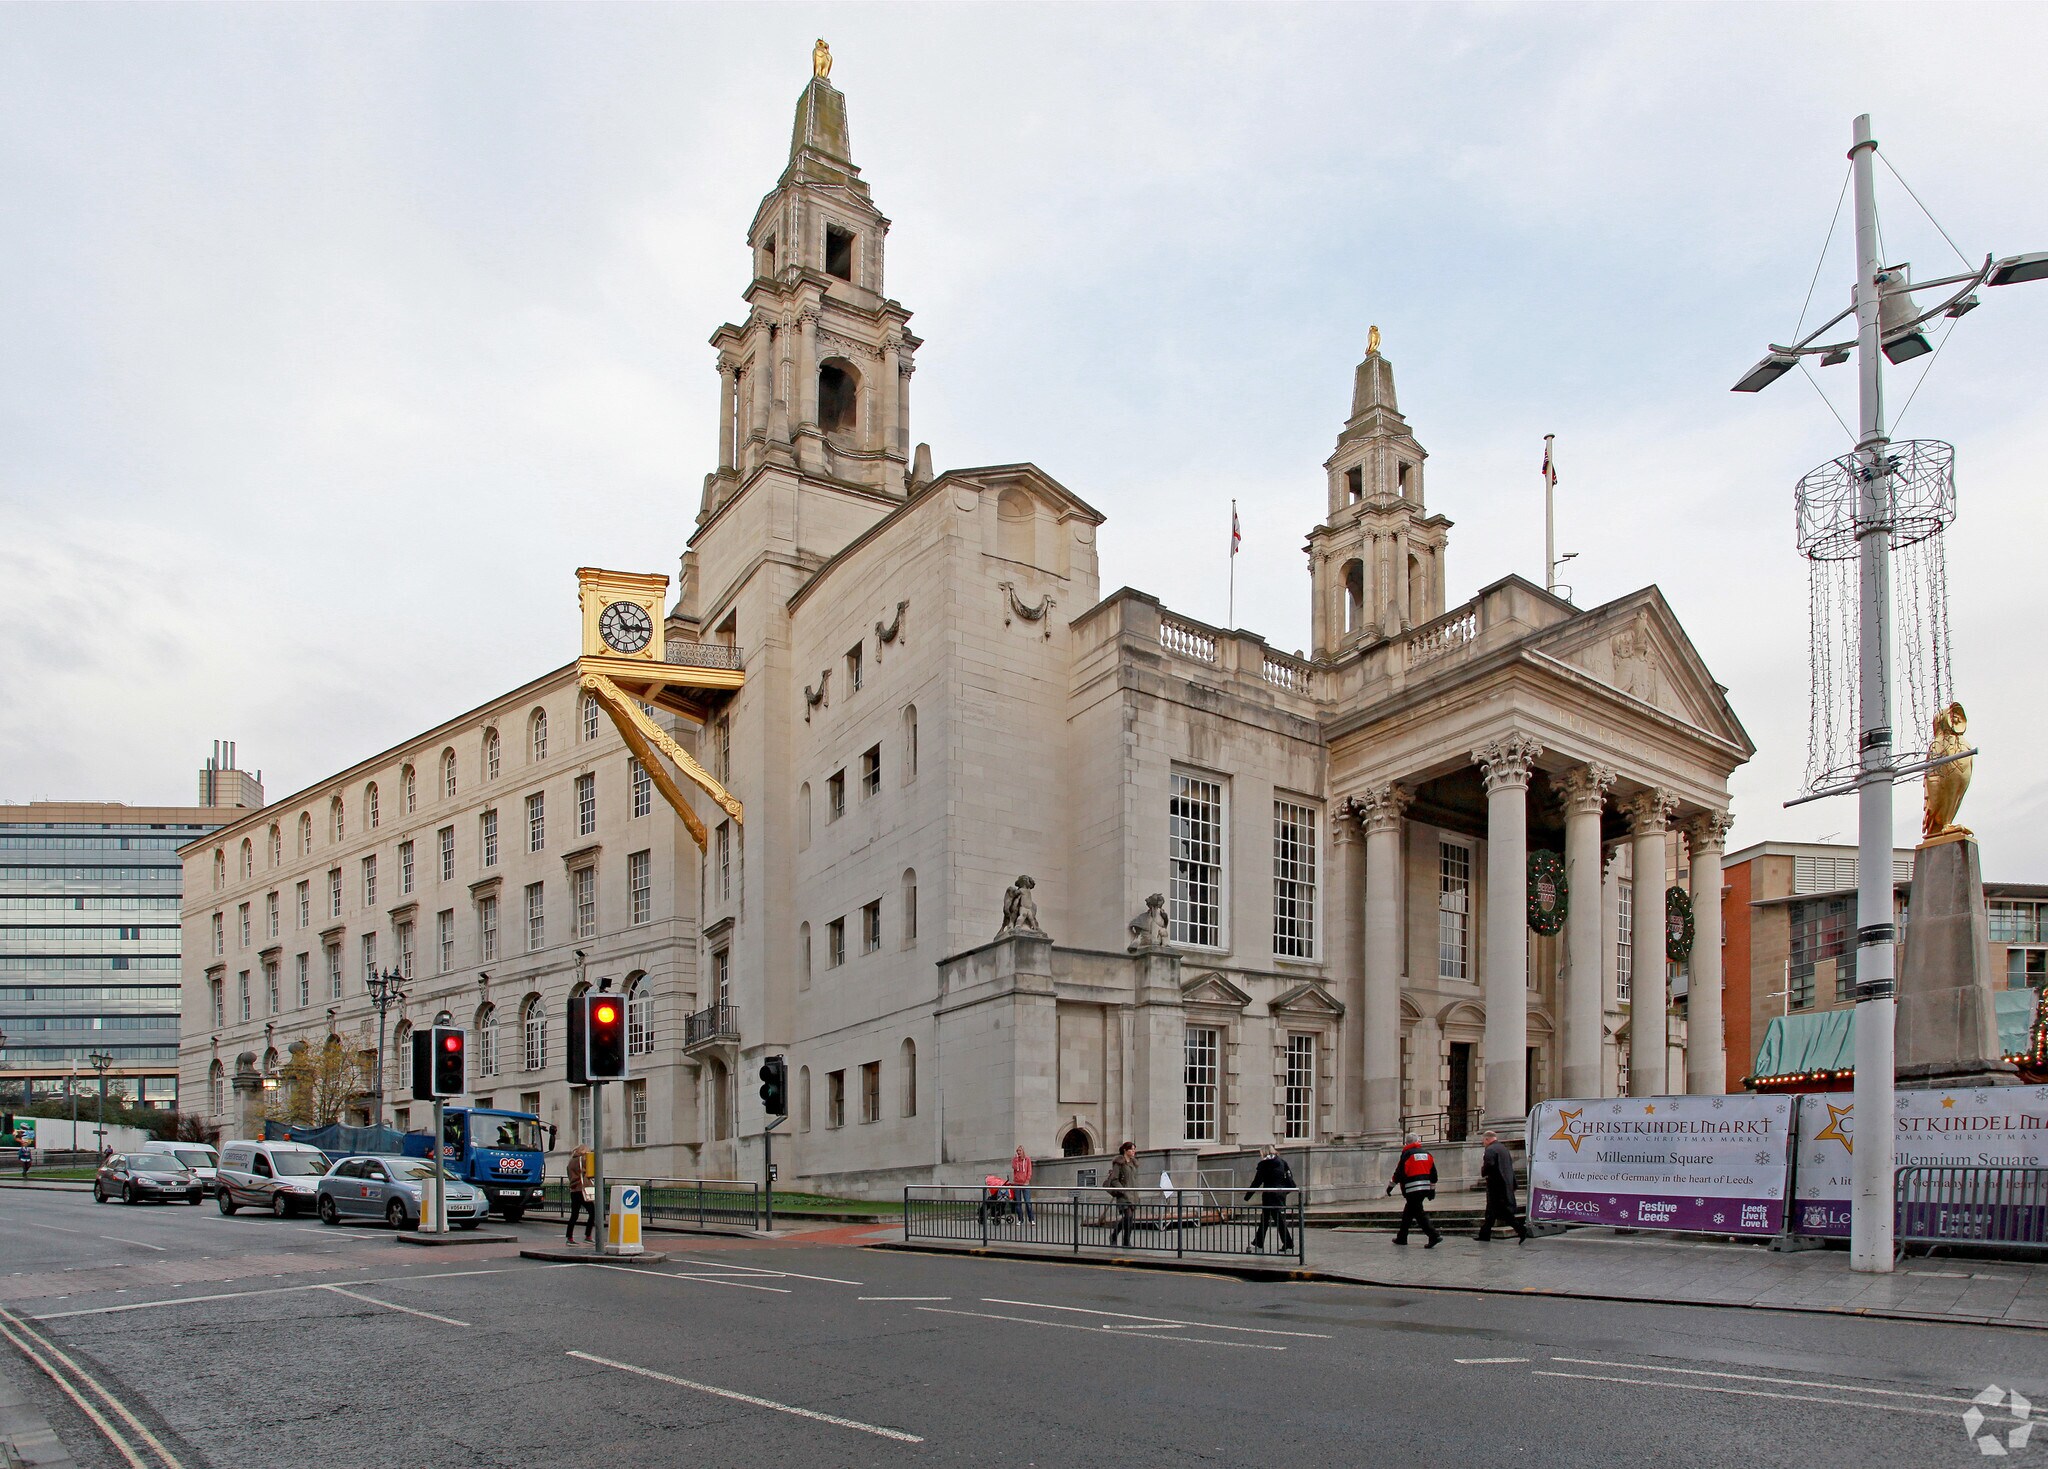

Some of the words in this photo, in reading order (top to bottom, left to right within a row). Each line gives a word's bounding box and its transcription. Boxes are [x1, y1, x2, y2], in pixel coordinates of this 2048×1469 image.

[1568, 1117, 1773, 1135] CHRISTKINDELMARKT
[1943, 1133, 2037, 1141] CHRISTMAS
[1596, 1151, 1665, 1163] Millennium
[1669, 1152, 1714, 1166] Square
[1895, 1152, 1971, 1166] illennium
[1978, 1152, 2039, 1166] Square
[1567, 1171, 1585, 1179] little
[1587, 1173, 1608, 1181] piece
[1610, 1172, 1621, 1180] of
[1621, 1173, 1660, 1183] Germany
[1662, 1174, 1671, 1182] in
[1673, 1174, 1687, 1183] the
[1689, 1174, 1711, 1183] heart
[1713, 1175, 1725, 1184] of
[1726, 1175, 1754, 1184] Leeds
[1828, 1177, 1838, 1185] A
[1558, 1199, 1600, 1213] Leeds
[1639, 1201, 1678, 1212] Festive
[1742, 1204, 1768, 1213] Leeds
[1638, 1211, 1670, 1222] Leeds
[1741, 1212, 1759, 1220] Live
[1760, 1212, 1767, 1220] it
[1741, 1219, 1761, 1228] Love
[1762, 1219, 1769, 1228] it
